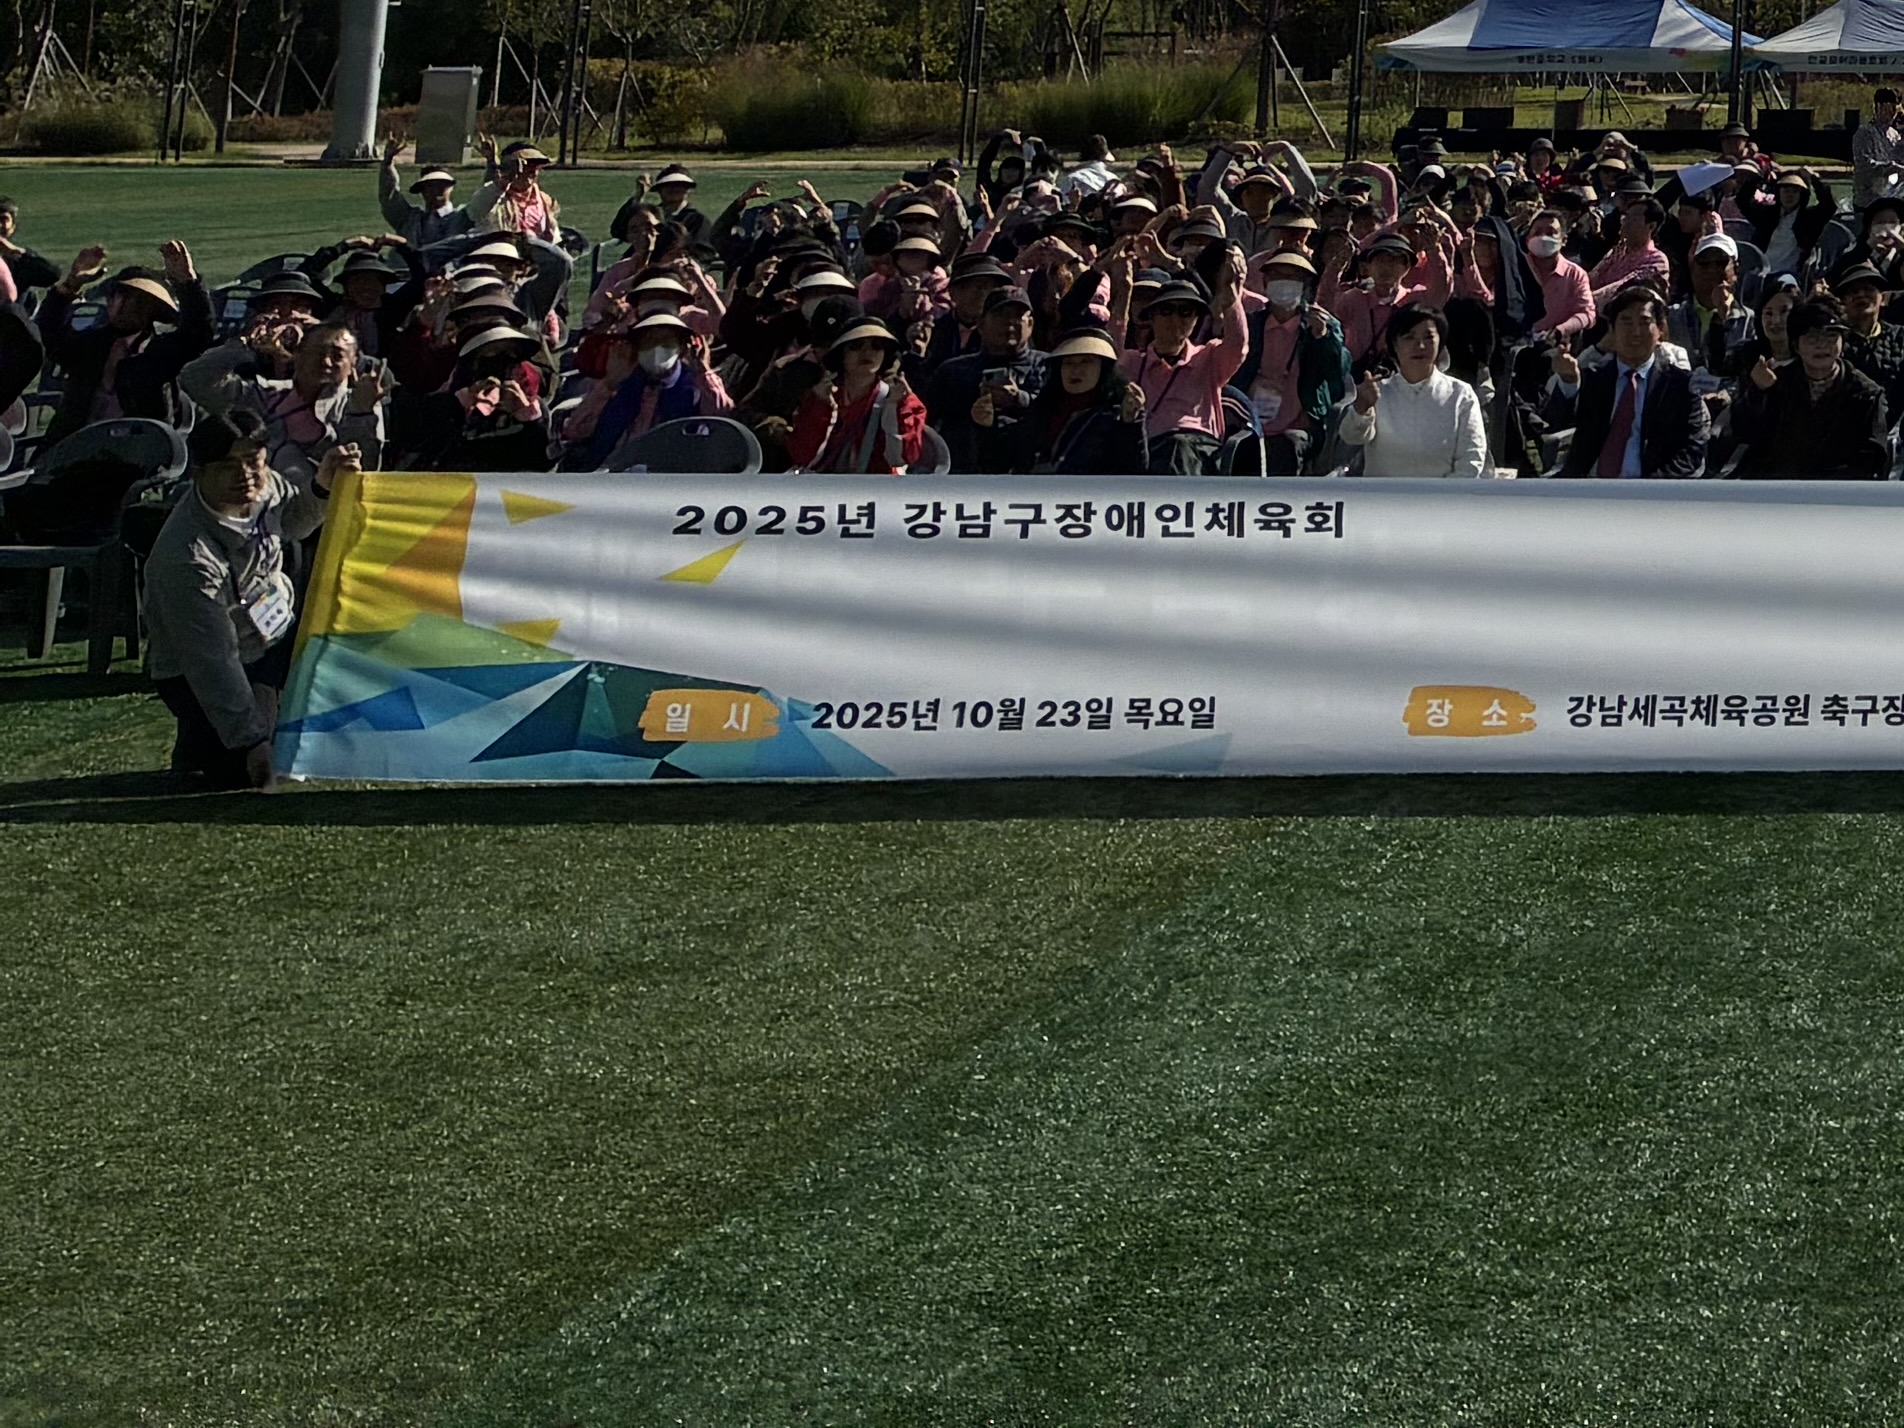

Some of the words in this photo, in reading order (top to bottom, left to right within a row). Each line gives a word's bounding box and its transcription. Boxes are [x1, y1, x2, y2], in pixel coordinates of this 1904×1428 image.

[671, 503, 880, 542] 2025년
[903, 499, 1347, 541] 강남구장애인체육회
[809, 695, 941, 733] 2025년
[951, 695, 1024, 733] 10월
[1035, 695, 1114, 733] 23일
[1123, 695, 1219, 733] 목요일
[1566, 693, 1812, 729] 강남세곡체육공원
